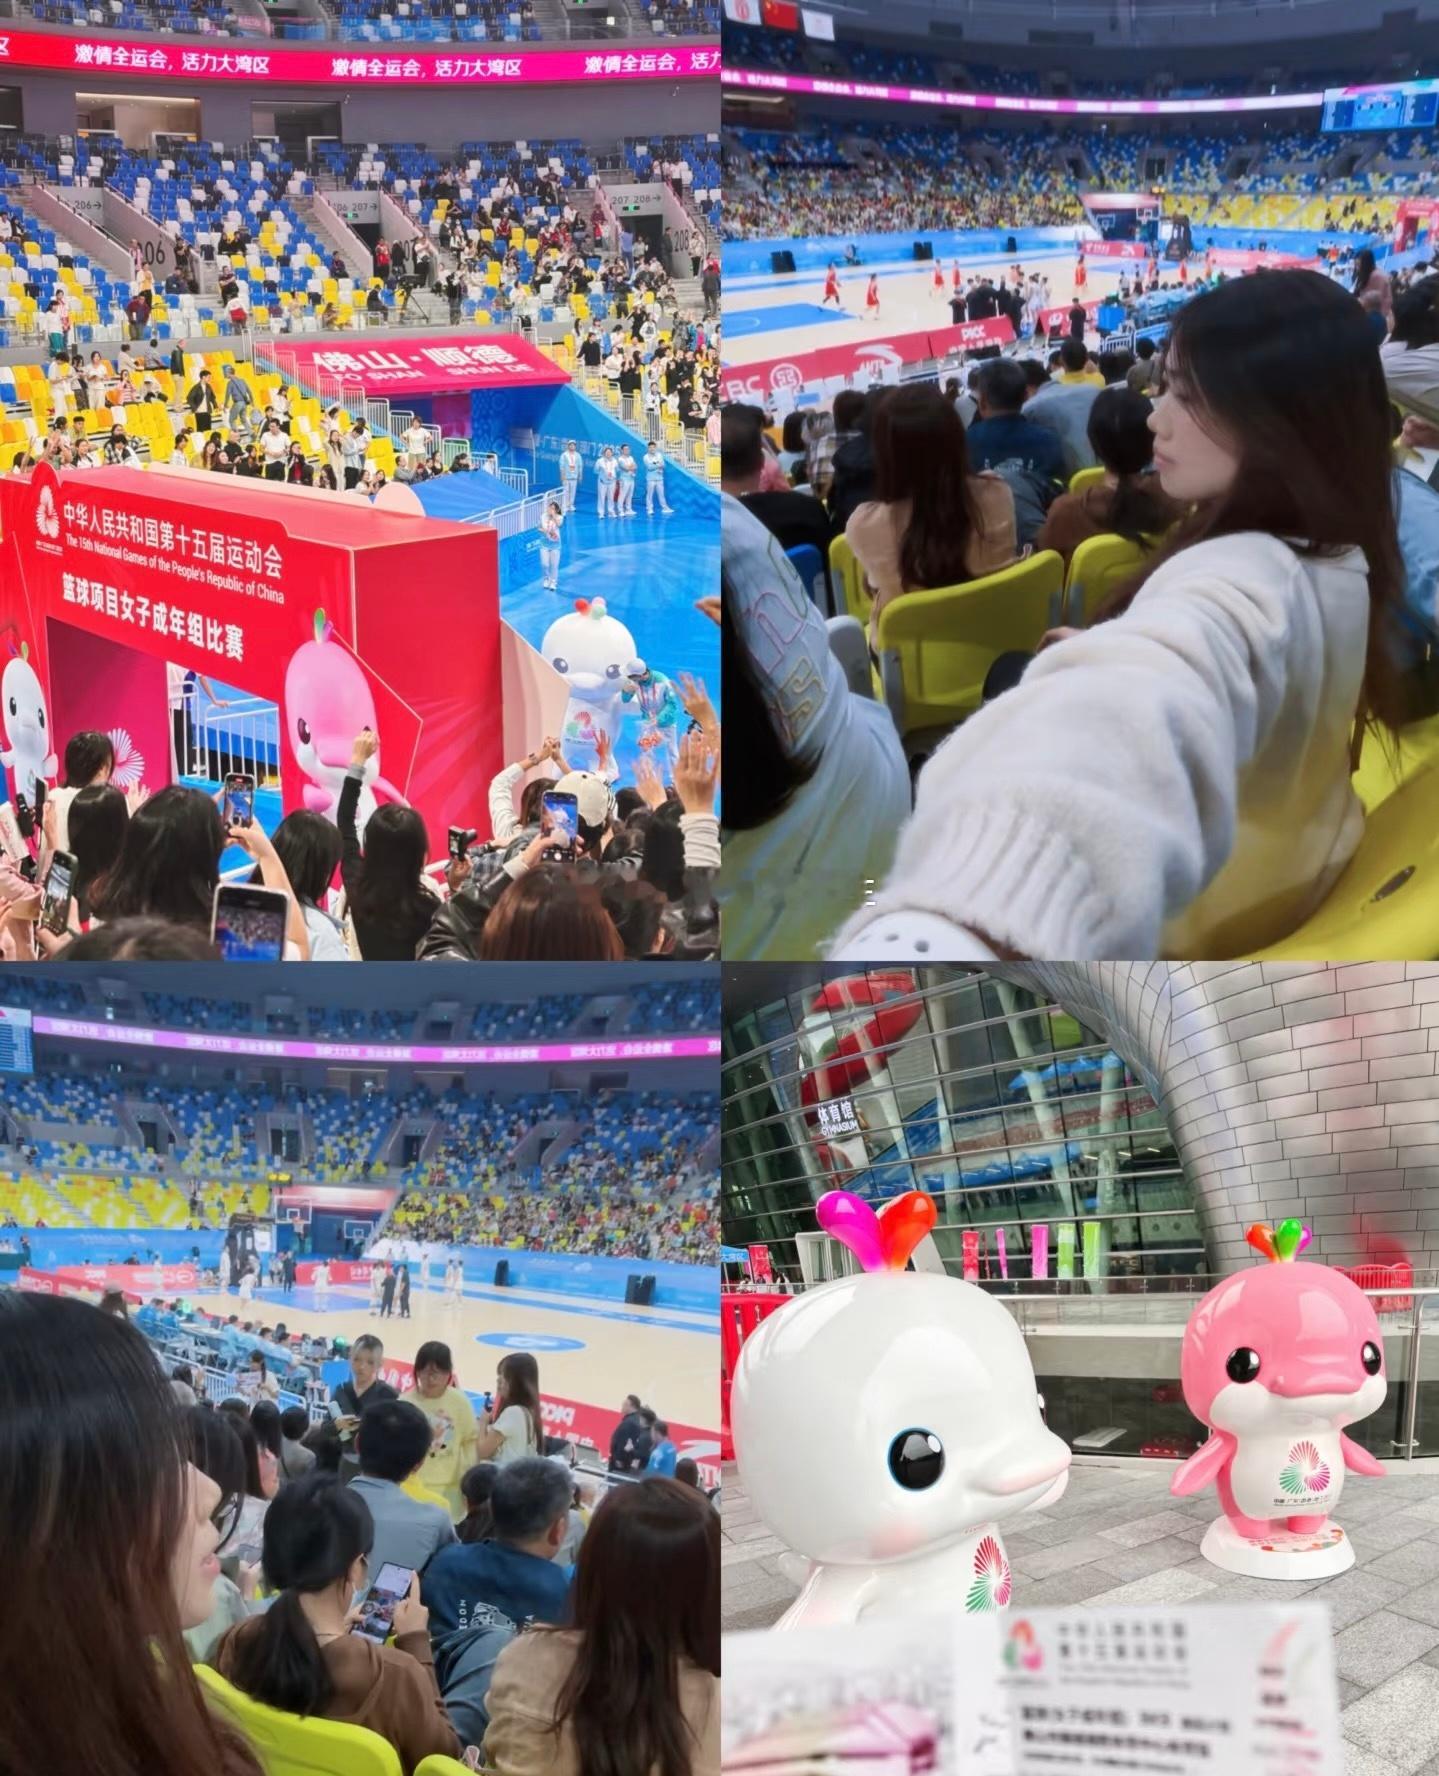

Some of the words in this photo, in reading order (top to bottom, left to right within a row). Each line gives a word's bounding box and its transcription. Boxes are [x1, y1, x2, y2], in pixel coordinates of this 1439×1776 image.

[75, 200, 92, 210] 206
[137, 240, 165, 266] 06
[367, 370, 426, 380] SHAN
[446, 365, 504, 376] SHUN
[505, 363, 535, 373] DE
[63, 500, 283, 579] 中华人民共和国第十五届运动会
[65, 532, 78, 547] The
[79, 536, 94, 551] 15th
[94, 540, 122, 560] National
[122, 547, 148, 566] Games
[149, 555, 157, 568] of
[158, 556, 171, 572] the
[171, 560, 205, 582] People's
[206, 569, 244, 592] Republic
[245, 580, 255, 595] of
[257, 583, 285, 605] China
[62, 571, 244, 663] 篮球项目女子成年组比赛
[818, 1100, 854, 1126] 体育馆
[821, 1119, 858, 1137] GYMNASIUM
